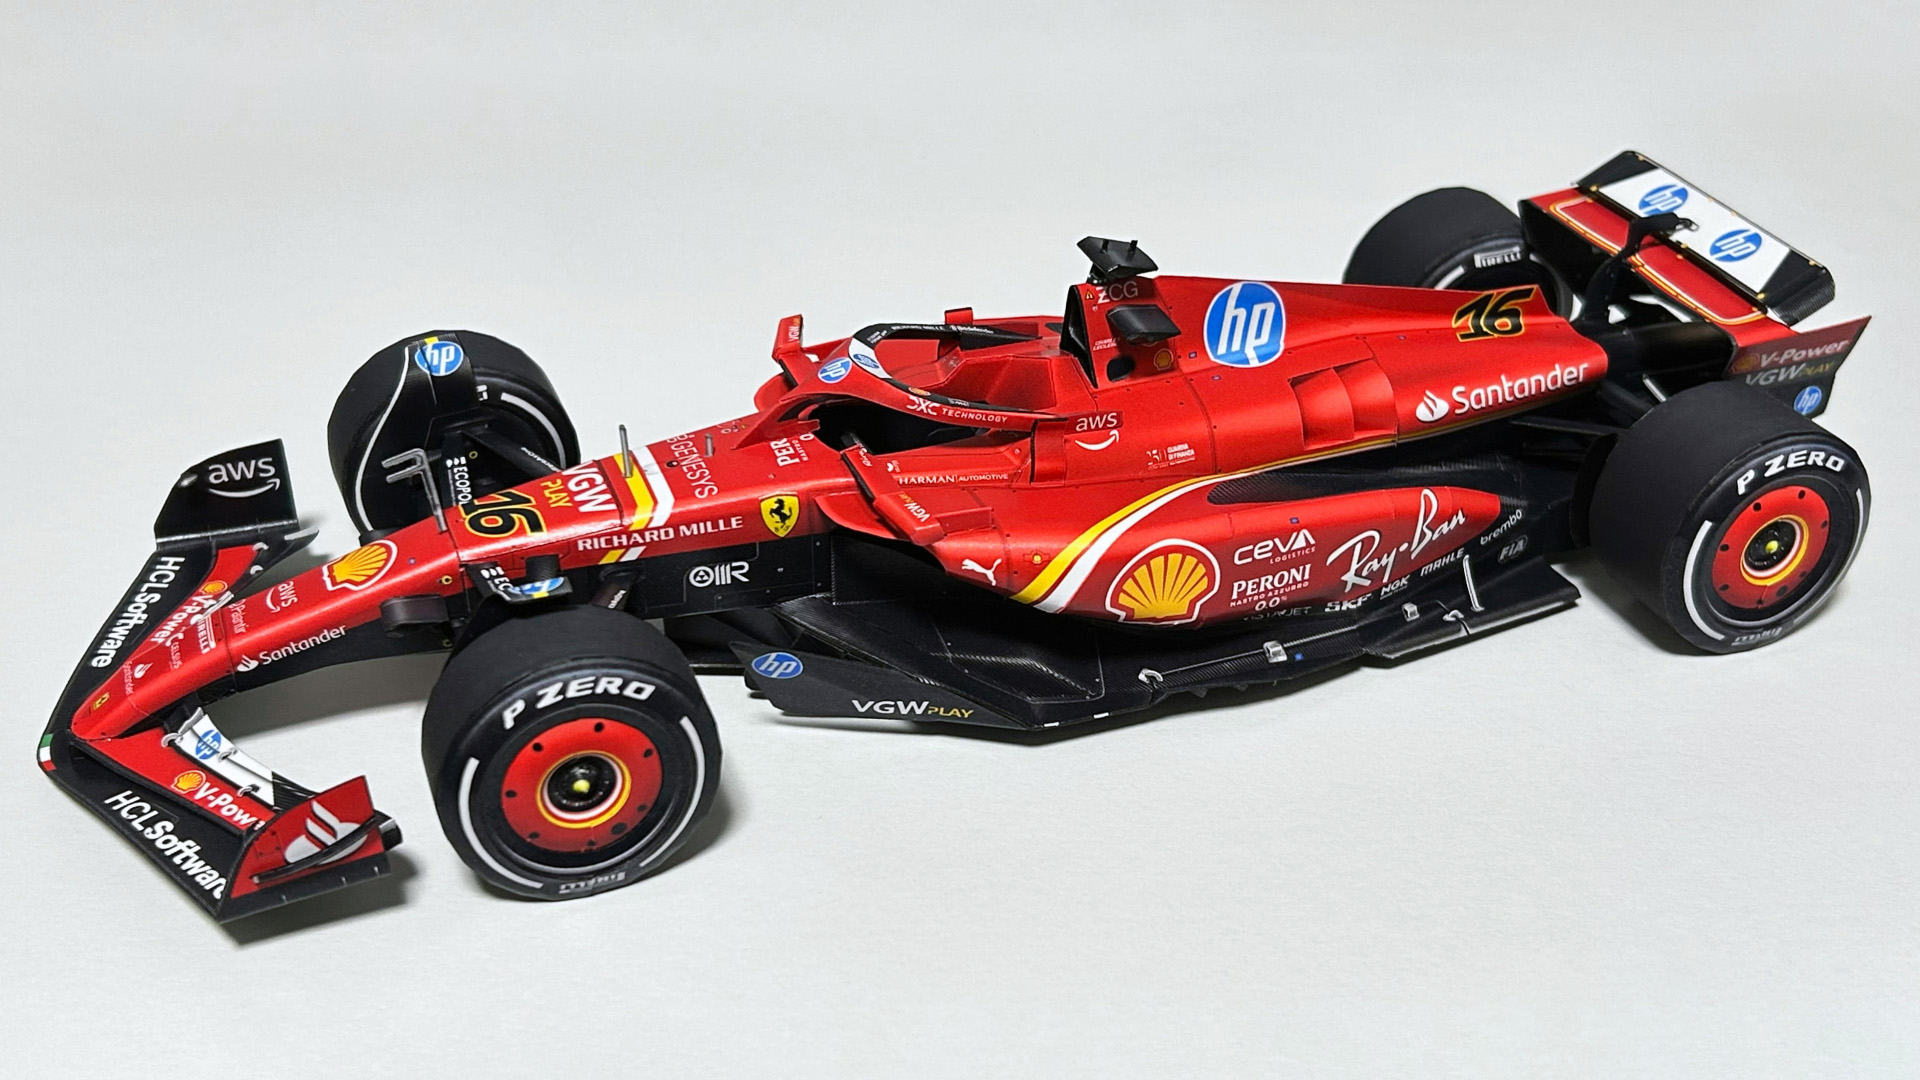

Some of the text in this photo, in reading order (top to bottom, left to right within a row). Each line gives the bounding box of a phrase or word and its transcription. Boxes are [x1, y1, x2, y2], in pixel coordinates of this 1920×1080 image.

[1641, 185, 1687, 215] hp
[1711, 230, 1761, 262] hp
[1214, 281, 1277, 367] hp
[1452, 286, 1536, 342] 16
[419, 341, 460, 376] hp
[1760, 340, 1849, 367] V-Power
[820, 358, 850, 382] hp
[1452, 363, 1588, 415] Santander
[1796, 387, 1820, 415] hp
[942, 408, 1008, 423] TECHNOLOGY
[1075, 412, 1118, 431] aws
[770, 438, 800, 467] PER
[208, 457, 276, 484] aws
[671, 439, 718, 498] GENESYS
[899, 474, 1008, 485] HARMAN AUTOMOTIVE
[1737, 450, 1845, 495] P ZERO
[540, 479, 573, 507] PLAY
[561, 460, 617, 512] VGW
[458, 489, 547, 537] 16
[1480, 509, 1523, 545] brembo
[577, 516, 744, 551] RICHARD MILLE
[1270, 546, 1316, 564] LOGISTICS
[1420, 547, 1464, 577] MAHLE
[1499, 538, 1525, 562] FIA
[281, 580, 299, 608] aws
[1230, 581, 1309, 607] NASTRO AZZURRO
[1231, 564, 1311, 600] PERONI
[1381, 575, 1410, 595] NGK
[91, 556, 185, 668] HCLSoftware
[1325, 592, 1373, 612] SKF
[151, 595, 214, 643] V-Power
[260, 624, 347, 666] Santander
[757, 652, 798, 679] hp
[502, 676, 656, 730] P ZERO
[195, 729, 221, 760] hp
[194, 784, 264, 831] V-Pow
